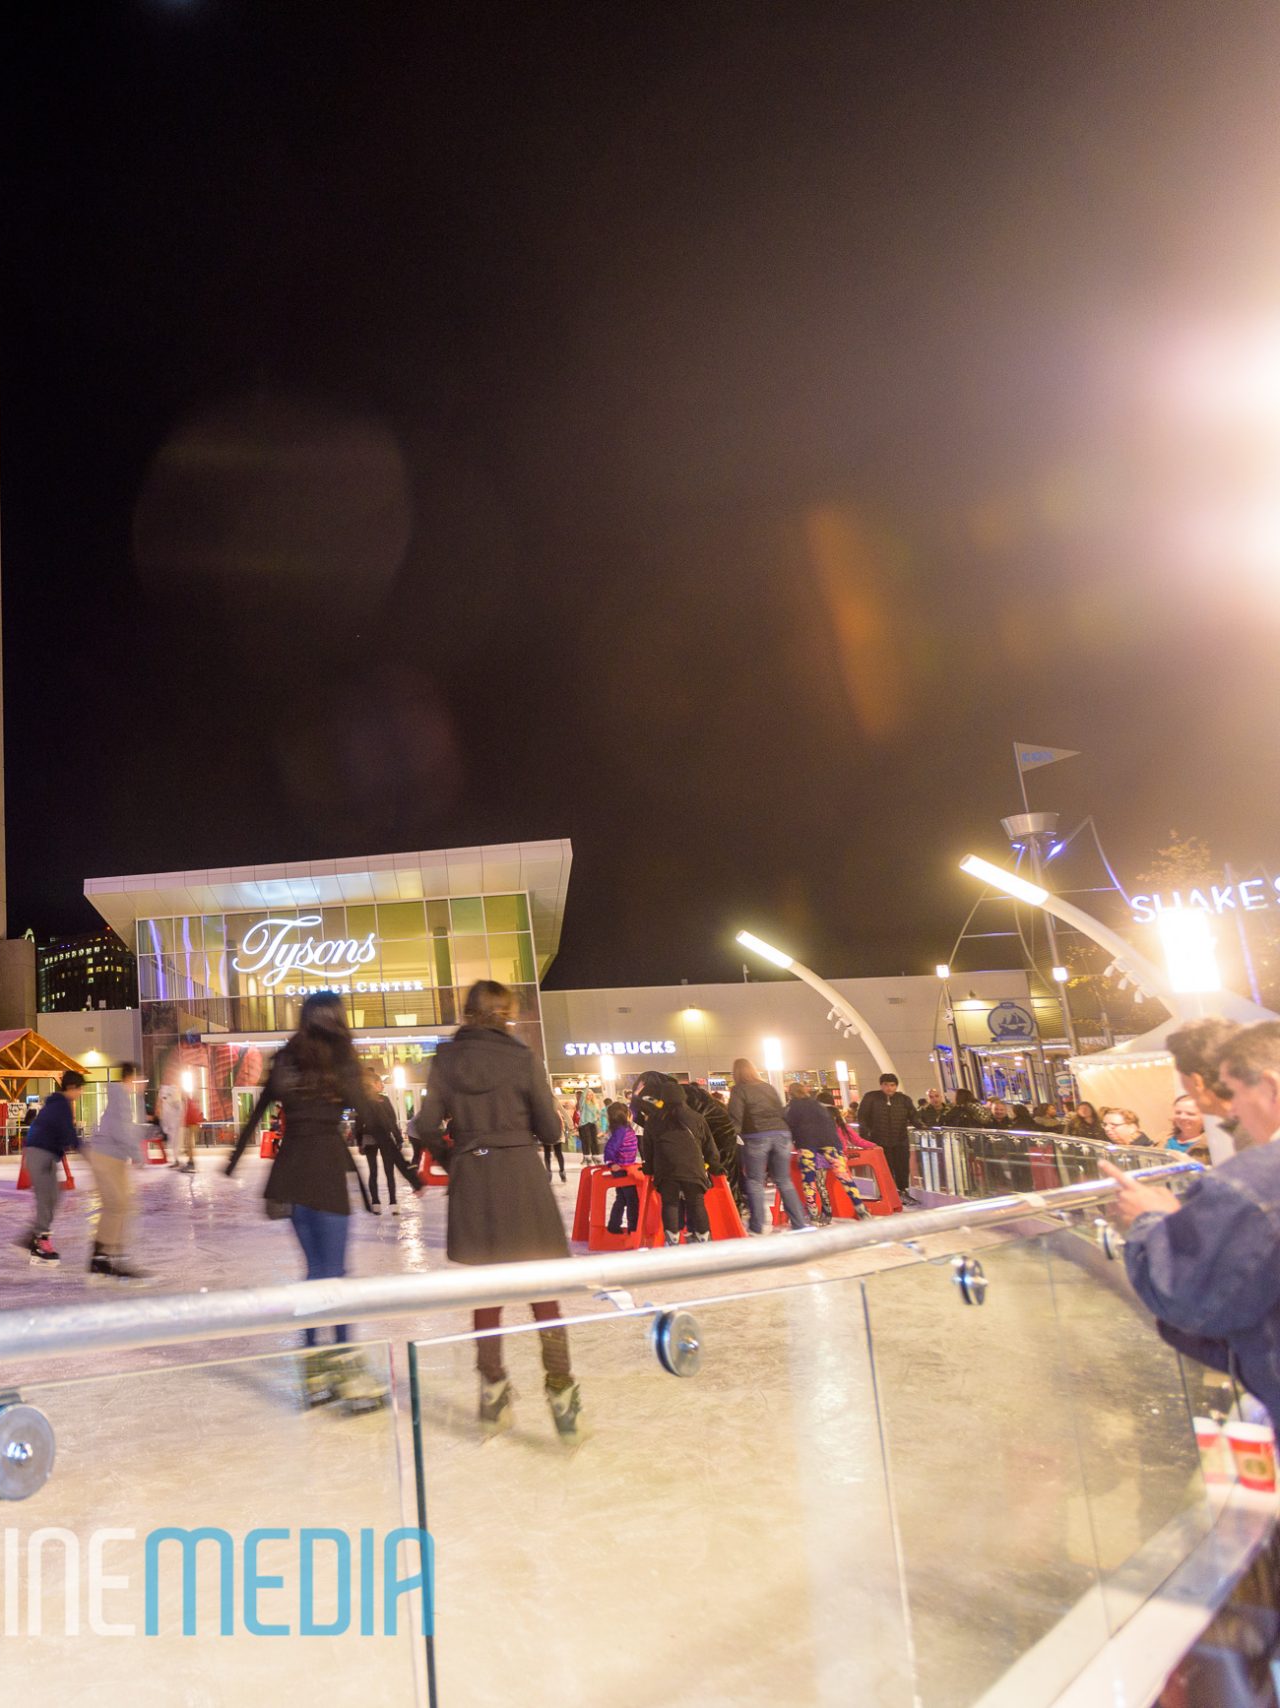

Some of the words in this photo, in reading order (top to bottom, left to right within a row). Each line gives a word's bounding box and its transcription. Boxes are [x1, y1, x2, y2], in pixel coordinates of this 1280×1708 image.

[1130, 877, 1280, 923] SHAKE
[232, 915, 376, 987] Tysons
[356, 980, 424, 993] CENTER
[564, 1040, 676, 1056] STARBUCKS
